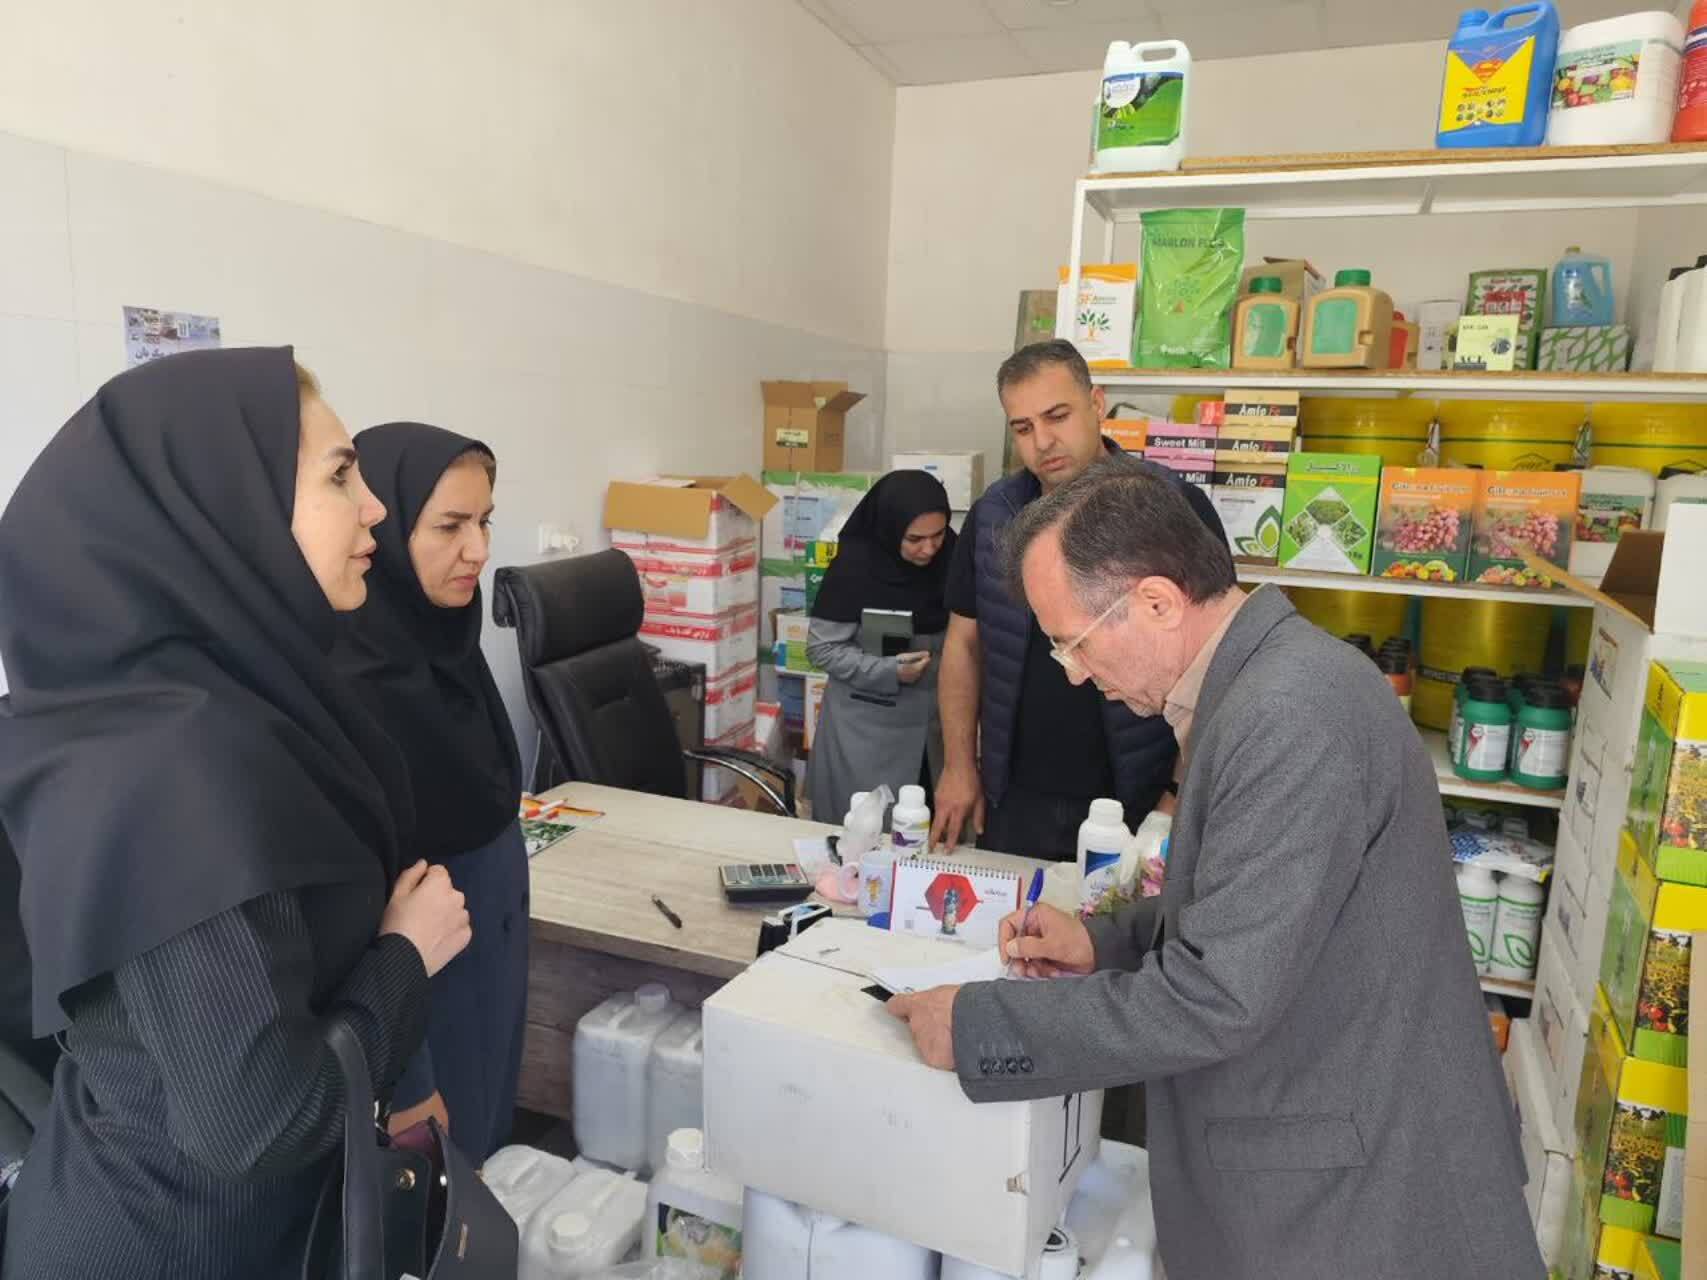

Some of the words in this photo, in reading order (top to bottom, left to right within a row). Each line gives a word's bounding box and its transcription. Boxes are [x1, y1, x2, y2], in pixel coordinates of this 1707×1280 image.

[1239, 404, 1267, 416] Amfo
[1154, 437, 1186, 448] Sweet
[1232, 441, 1260, 452] Amfo
[1225, 474, 1258, 488] Amfo
